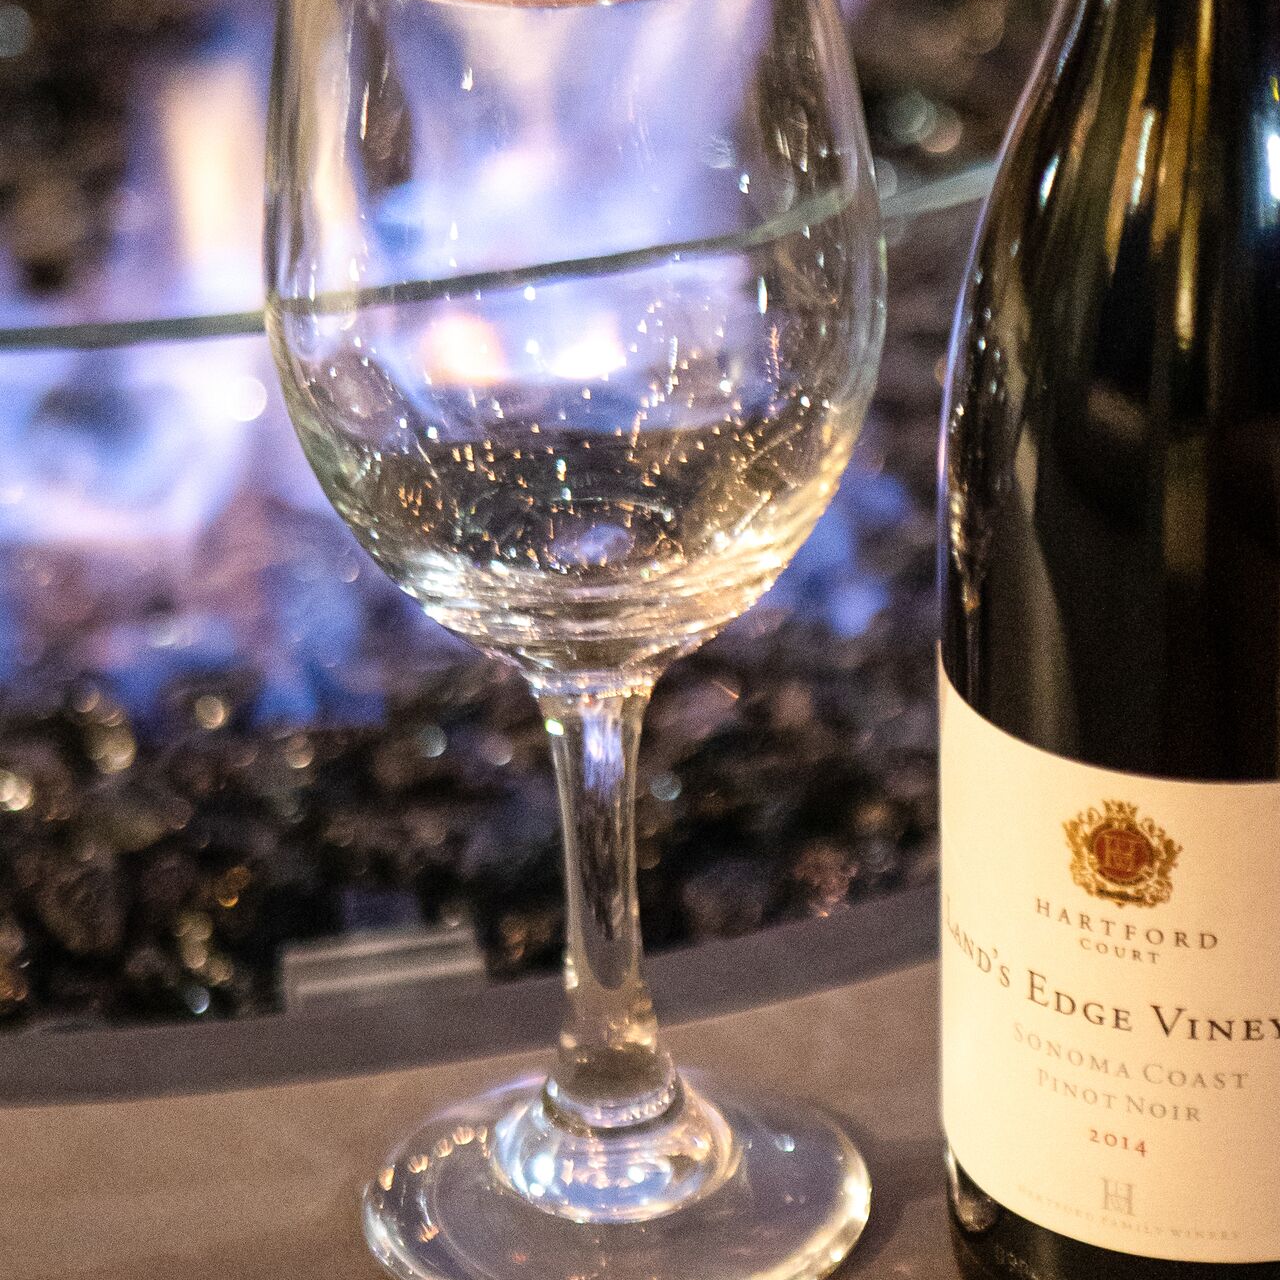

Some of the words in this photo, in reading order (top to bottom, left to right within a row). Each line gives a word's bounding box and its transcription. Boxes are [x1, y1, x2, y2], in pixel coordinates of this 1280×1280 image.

[1036, 897, 1218, 950] HARTFORD
[1079, 937, 1160, 964] COURT
[1027, 969, 1133, 1032] EDGE
[1012, 1021, 1131, 1080] SONOMA
[1142, 1062, 1250, 1090] COAST
[1037, 1066, 1118, 1111] PINOT
[1124, 1095, 1201, 1122] NOIR
[1089, 1129, 1148, 1157] 2014
